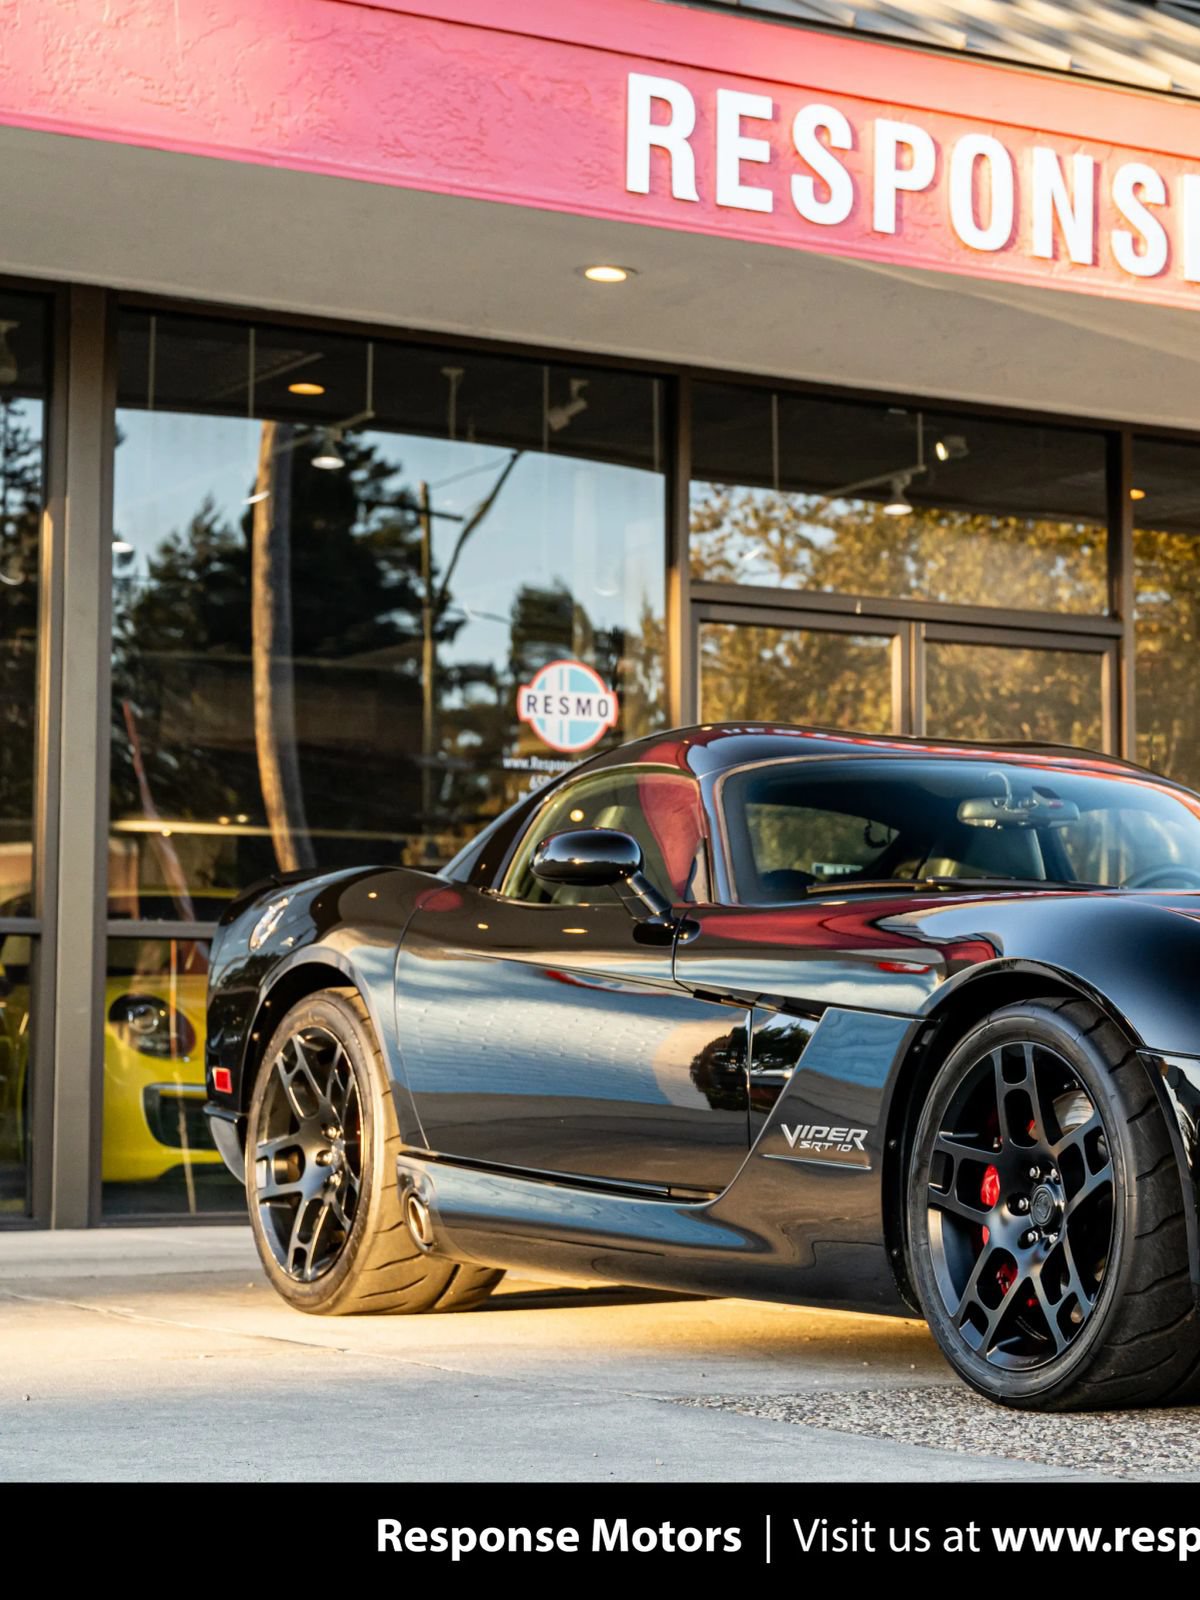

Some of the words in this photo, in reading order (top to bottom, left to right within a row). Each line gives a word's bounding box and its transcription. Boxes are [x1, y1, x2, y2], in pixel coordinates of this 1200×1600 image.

[526, 694, 609, 718] RESMO
[780, 1123, 869, 1151] VIPER
[799, 1140, 833, 1152] SRT
[836, 1143, 853, 1152] 10
